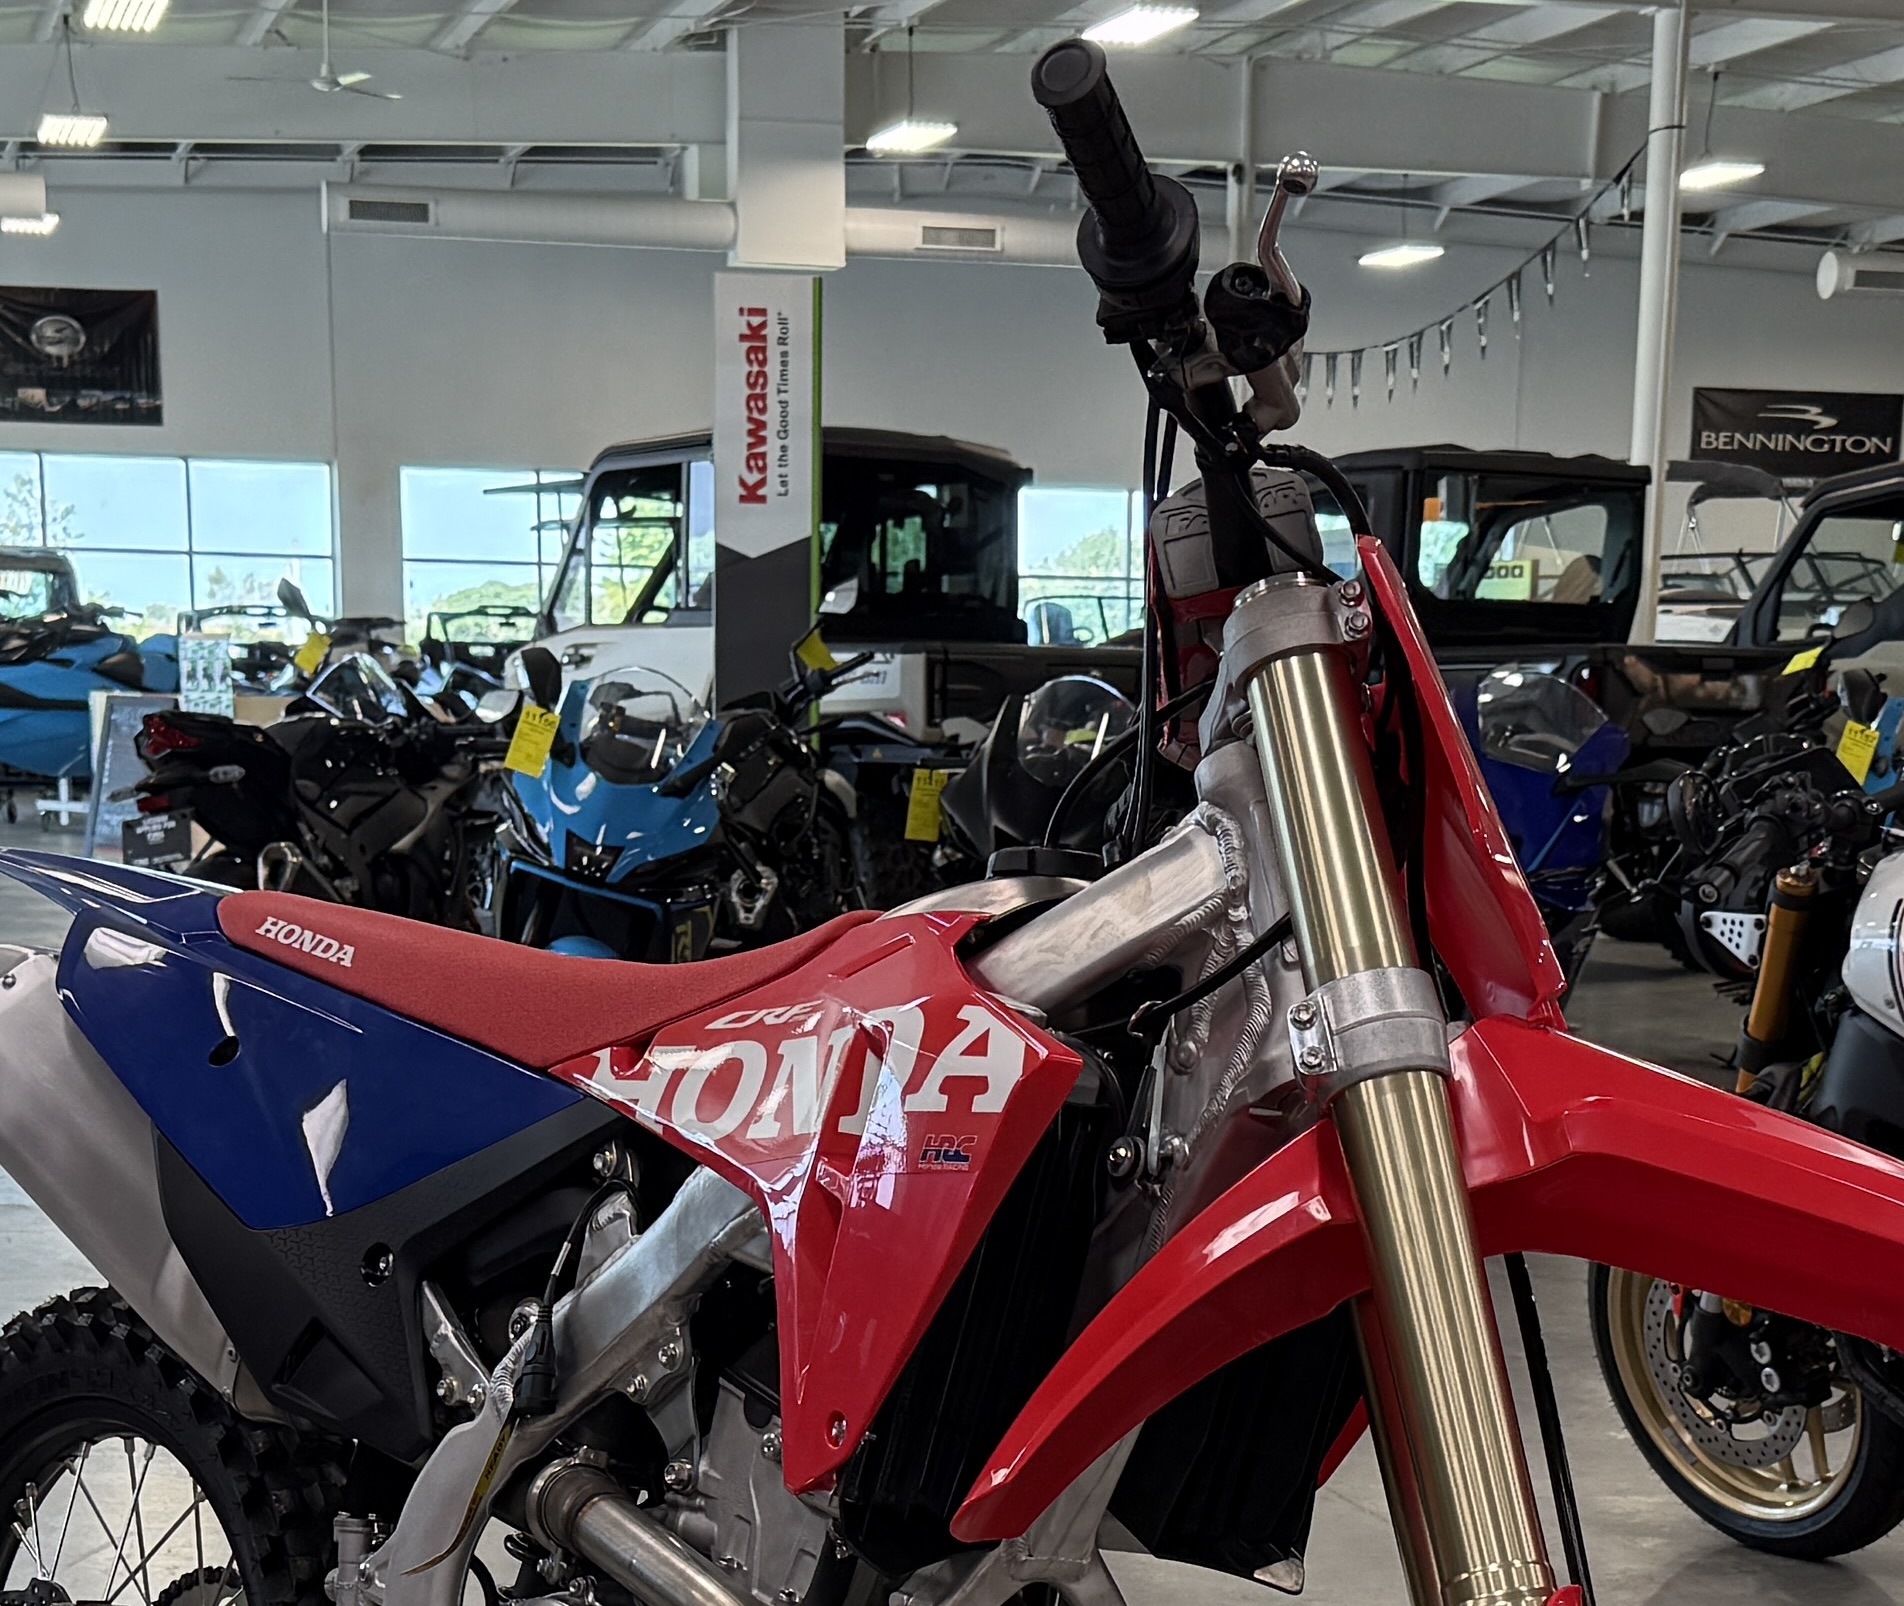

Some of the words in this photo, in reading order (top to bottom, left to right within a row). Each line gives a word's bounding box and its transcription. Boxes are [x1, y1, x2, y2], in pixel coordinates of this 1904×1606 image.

[776, 350, 790, 397] Times
[738, 306, 768, 505] Kawasaki
[776, 400, 790, 441] Good
[776, 444, 790, 467] the
[1700, 430, 1893, 454] BENNINGTON
[776, 474, 790, 497] Let
[255, 916, 355, 968] HONDA
[594, 1003, 1027, 1141] HONDA
[919, 1134, 978, 1165] HRC
